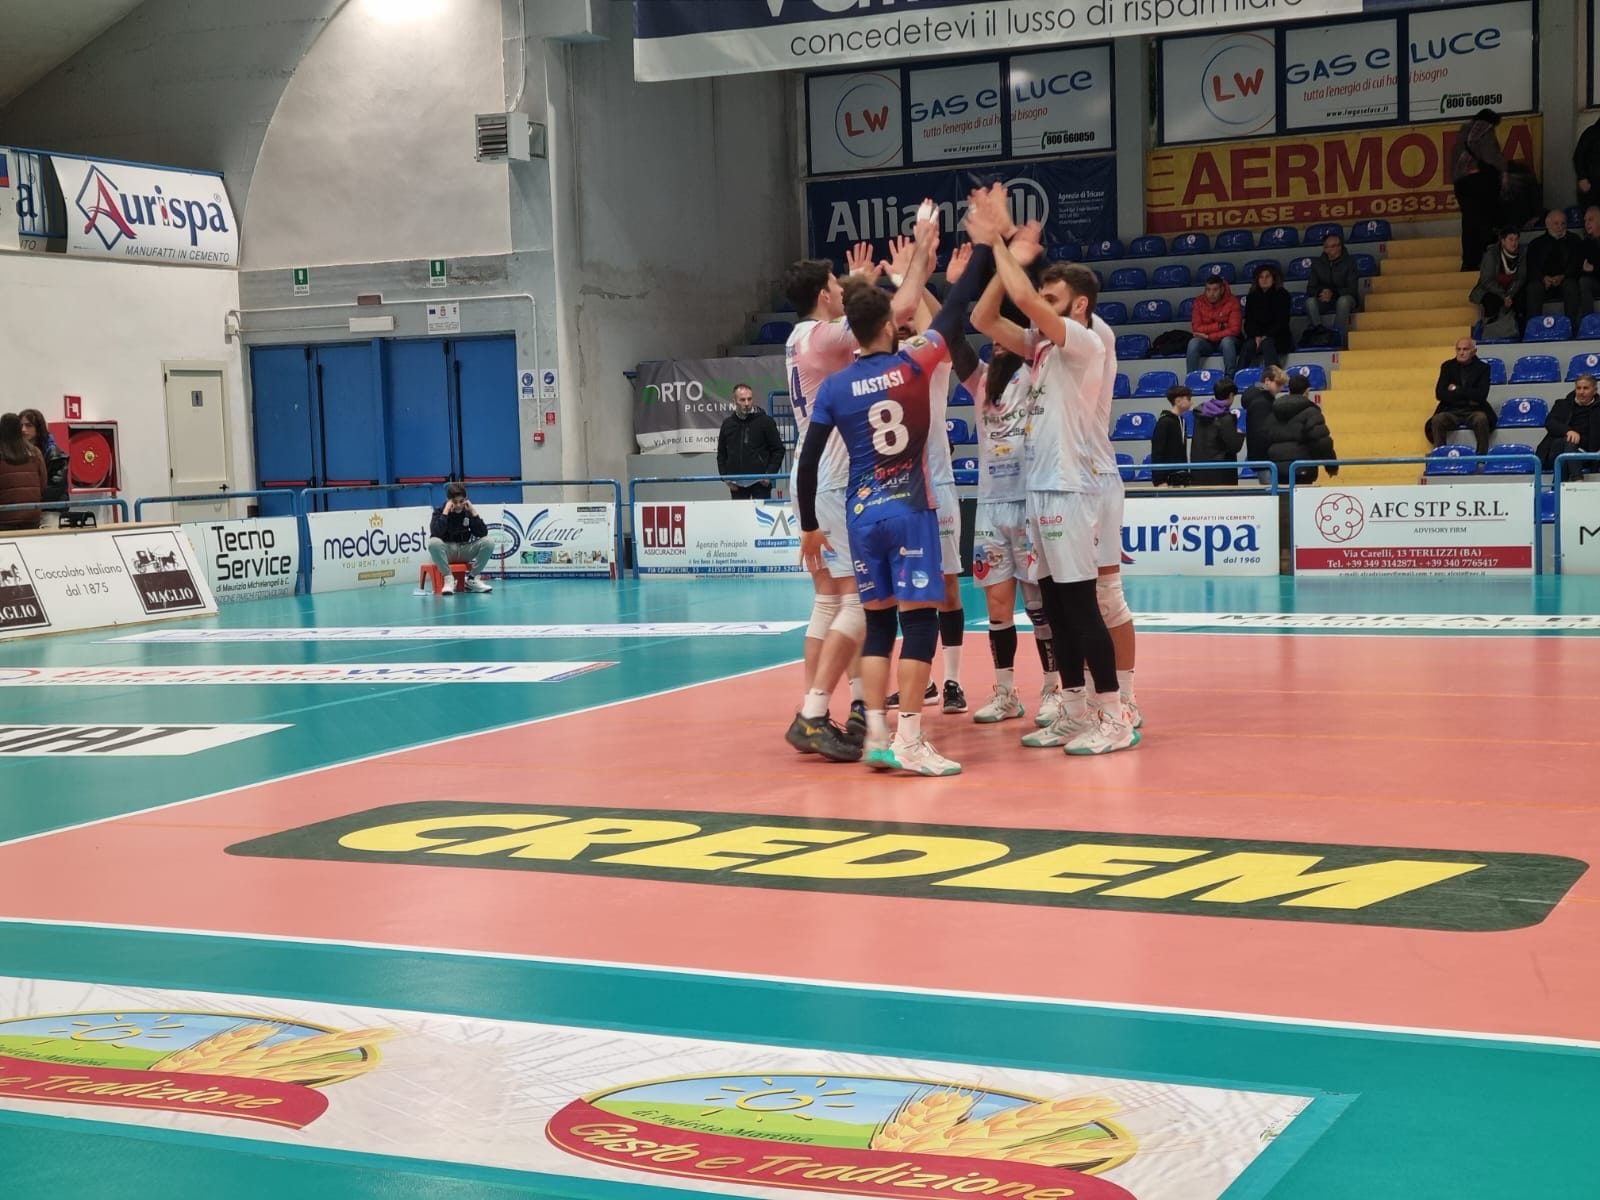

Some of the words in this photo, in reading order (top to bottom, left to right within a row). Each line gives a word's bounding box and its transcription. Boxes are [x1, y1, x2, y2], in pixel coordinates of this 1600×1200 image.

[790, 11, 975, 56] concedetevi
[986, 9, 996, 37] il
[1008, 6, 1075, 35] lusso
[1087, 0, 1113, 26] di
[1286, 54, 1357, 85] GAS
[1365, 48, 1390, 69] e
[1213, 68, 1264, 102] LW
[1362, 78, 1371, 91] di
[1372, 75, 1385, 89] cui
[1413, 67, 1449, 84] bisogno
[910, 94, 969, 123] GAS
[976, 89, 998, 109] e
[1446, 97, 1464, 109] 800
[1465, 93, 1503, 107] 660850
[845, 105, 890, 137] LW
[1017, 107, 1048, 121] bisogno
[1046, 133, 1063, 145] 800
[1063, 131, 1095, 143] 660850
[84, 173, 230, 247] Aurispa
[1182, 205, 1297, 229] TRICASE
[1319, 202, 1361, 219] tel.
[125, 245, 175, 259] MANUFATTI
[177, 250, 187, 260] IN
[189, 250, 230, 263] CEMENTO
[852, 370, 905, 397] NASTASI
[685, 402, 737, 413] PICCINN
[867, 399, 910, 456] 8
[1369, 501, 1409, 519] AFC
[1414, 501, 1454, 518] STP
[1458, 499, 1510, 518] S.R.L.
[503, 508, 584, 541] Valente
[645, 527, 685, 546] TUA
[1413, 527, 1449, 535] ADVISORY
[1451, 526, 1467, 534] FIRM
[211, 525, 275, 552] Tecno
[323, 526, 427, 561] medGuest
[696, 540, 719, 549] Agenzia
[719, 539, 748, 549] Principale
[1120, 514, 1260, 566] urispa
[216, 550, 292, 581] Service
[342, 561, 356, 569] YOU
[1223, 556, 1237, 564] dal
[1239, 556, 1261, 564] 1960
[1327, 560, 1343, 568] Tel.
[1346, 560, 1362, 568] +39
[1363, 560, 1379, 568] 349
[1381, 560, 1417, 568] 3142871
[1425, 560, 1442, 568] +39
[1444, 559, 1460, 567] 340
[1462, 559, 1499, 567] 7765417
[1343, 550, 1359, 558] Via
[1360, 549, 1394, 559] Carelli,
[1397, 549, 1407, 558] 13
[1409, 549, 1458, 558] TERLIZZI
[1460, 549, 1482, 558] (BA)
[34, 564, 85, 580] Cioccolato
[86, 561, 123, 576] Italiano
[65, 583, 82, 597] dal
[83, 581, 109, 595] 1875
[144, 588, 194, 604] MAGLIO
[223, 583, 247, 592] Maurizio
[338, 812, 1486, 910] CREDEM
[24, 1075, 283, 1109] Tradizione
[569, 1123, 700, 1162] Gusto
[695, 1156, 744, 1169] e
[747, 1155, 1075, 1200] Tradizione
